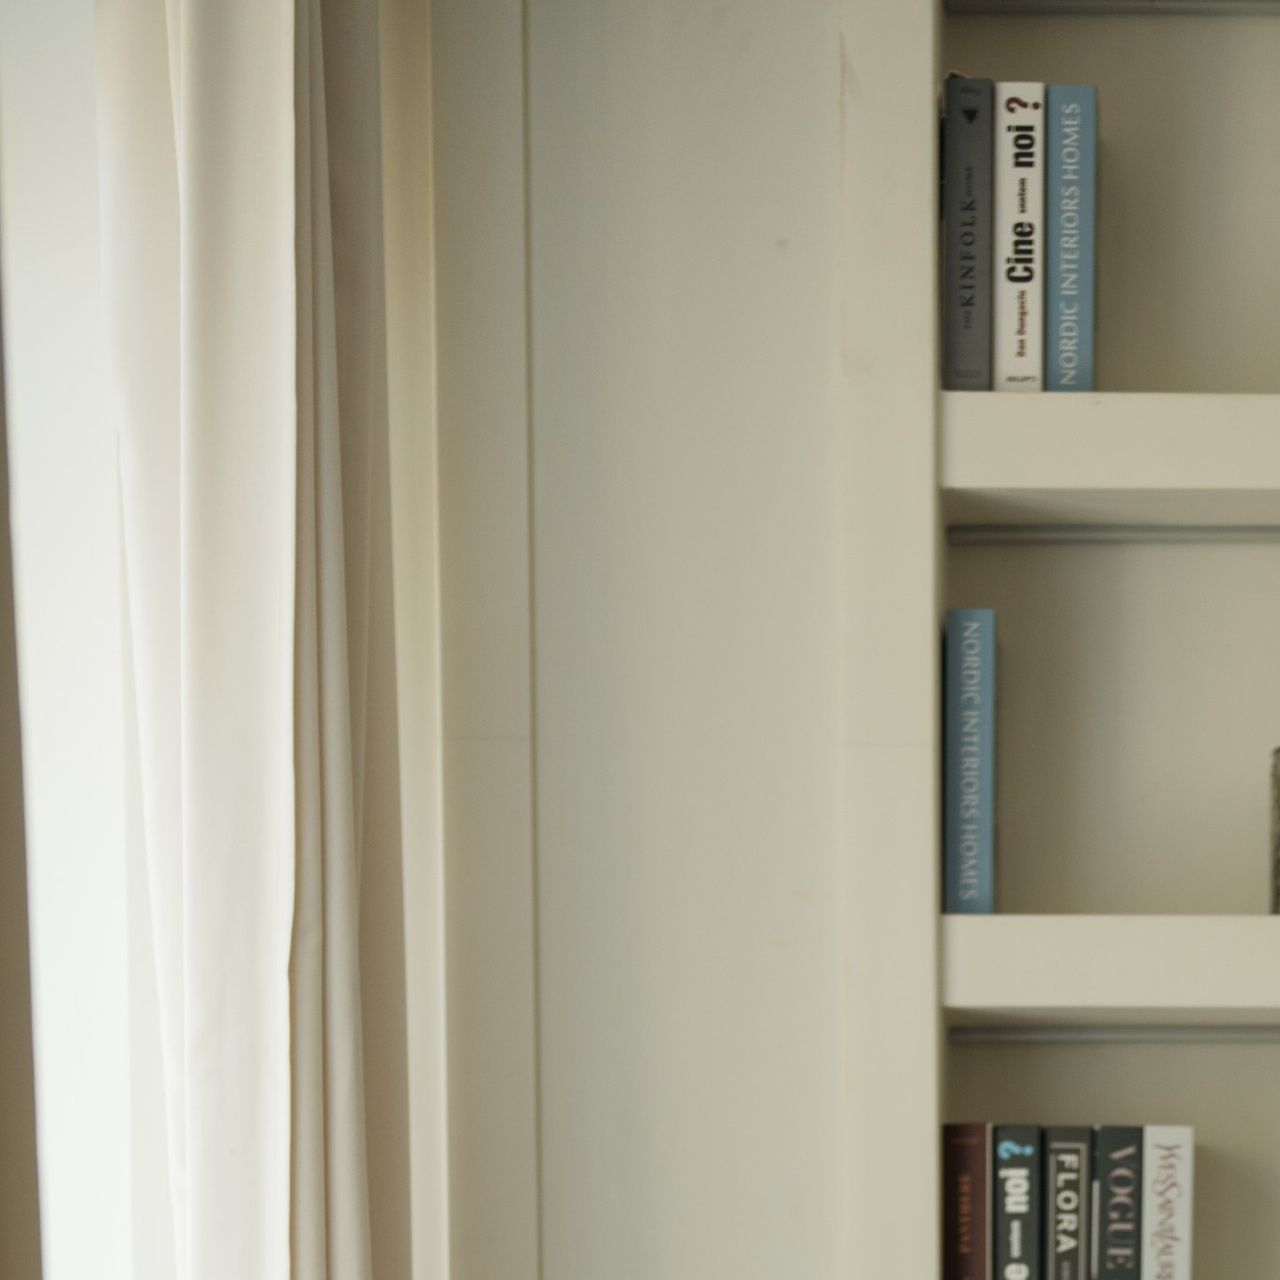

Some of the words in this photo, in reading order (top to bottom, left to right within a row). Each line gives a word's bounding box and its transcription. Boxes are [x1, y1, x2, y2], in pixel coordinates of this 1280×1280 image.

[1005, 97, 1040, 114] ?
[1061, 103, 1080, 179] HOMES
[1007, 125, 1034, 168] noi
[959, 199, 976, 308] KINFOLK
[1004, 222, 1035, 283] Cine
[1060, 186, 1080, 295] INTERIORS
[1059, 302, 1079, 385] NORDIC
[962, 621, 980, 704] NORDIC
[961, 711, 979, 818] INTERIORS
[959, 824, 977, 900] HOMES
[997, 1140, 1035, 1160] ?
[999, 1167, 1029, 1214] noi
[1056, 1154, 1080, 1253] FLORA
[1106, 1144, 1137, 1270] VOGUE
